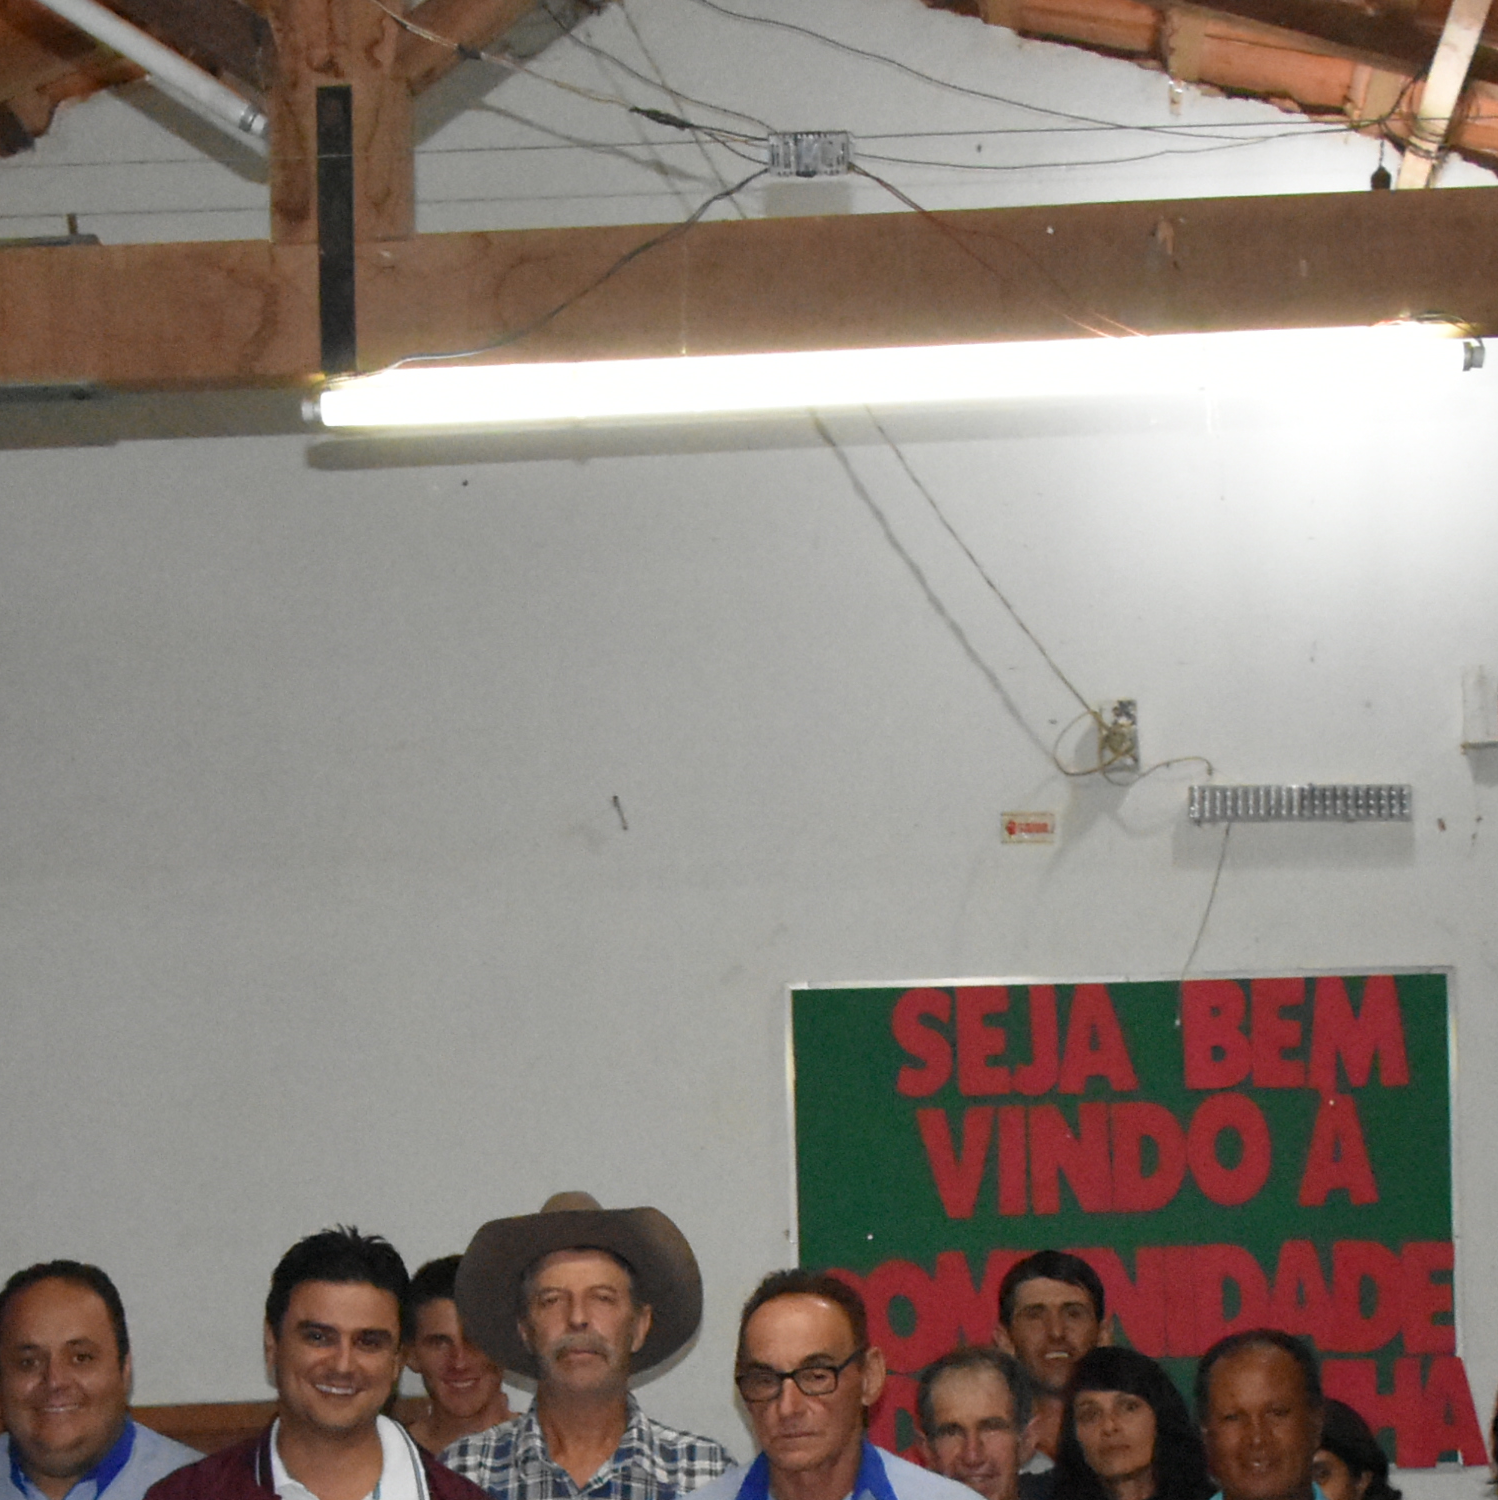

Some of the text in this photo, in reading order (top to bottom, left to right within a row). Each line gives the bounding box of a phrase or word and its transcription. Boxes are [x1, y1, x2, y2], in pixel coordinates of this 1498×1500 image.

[891, 974, 1410, 1098] SEJA BEM
[915, 1091, 1272, 1220] VINDO
